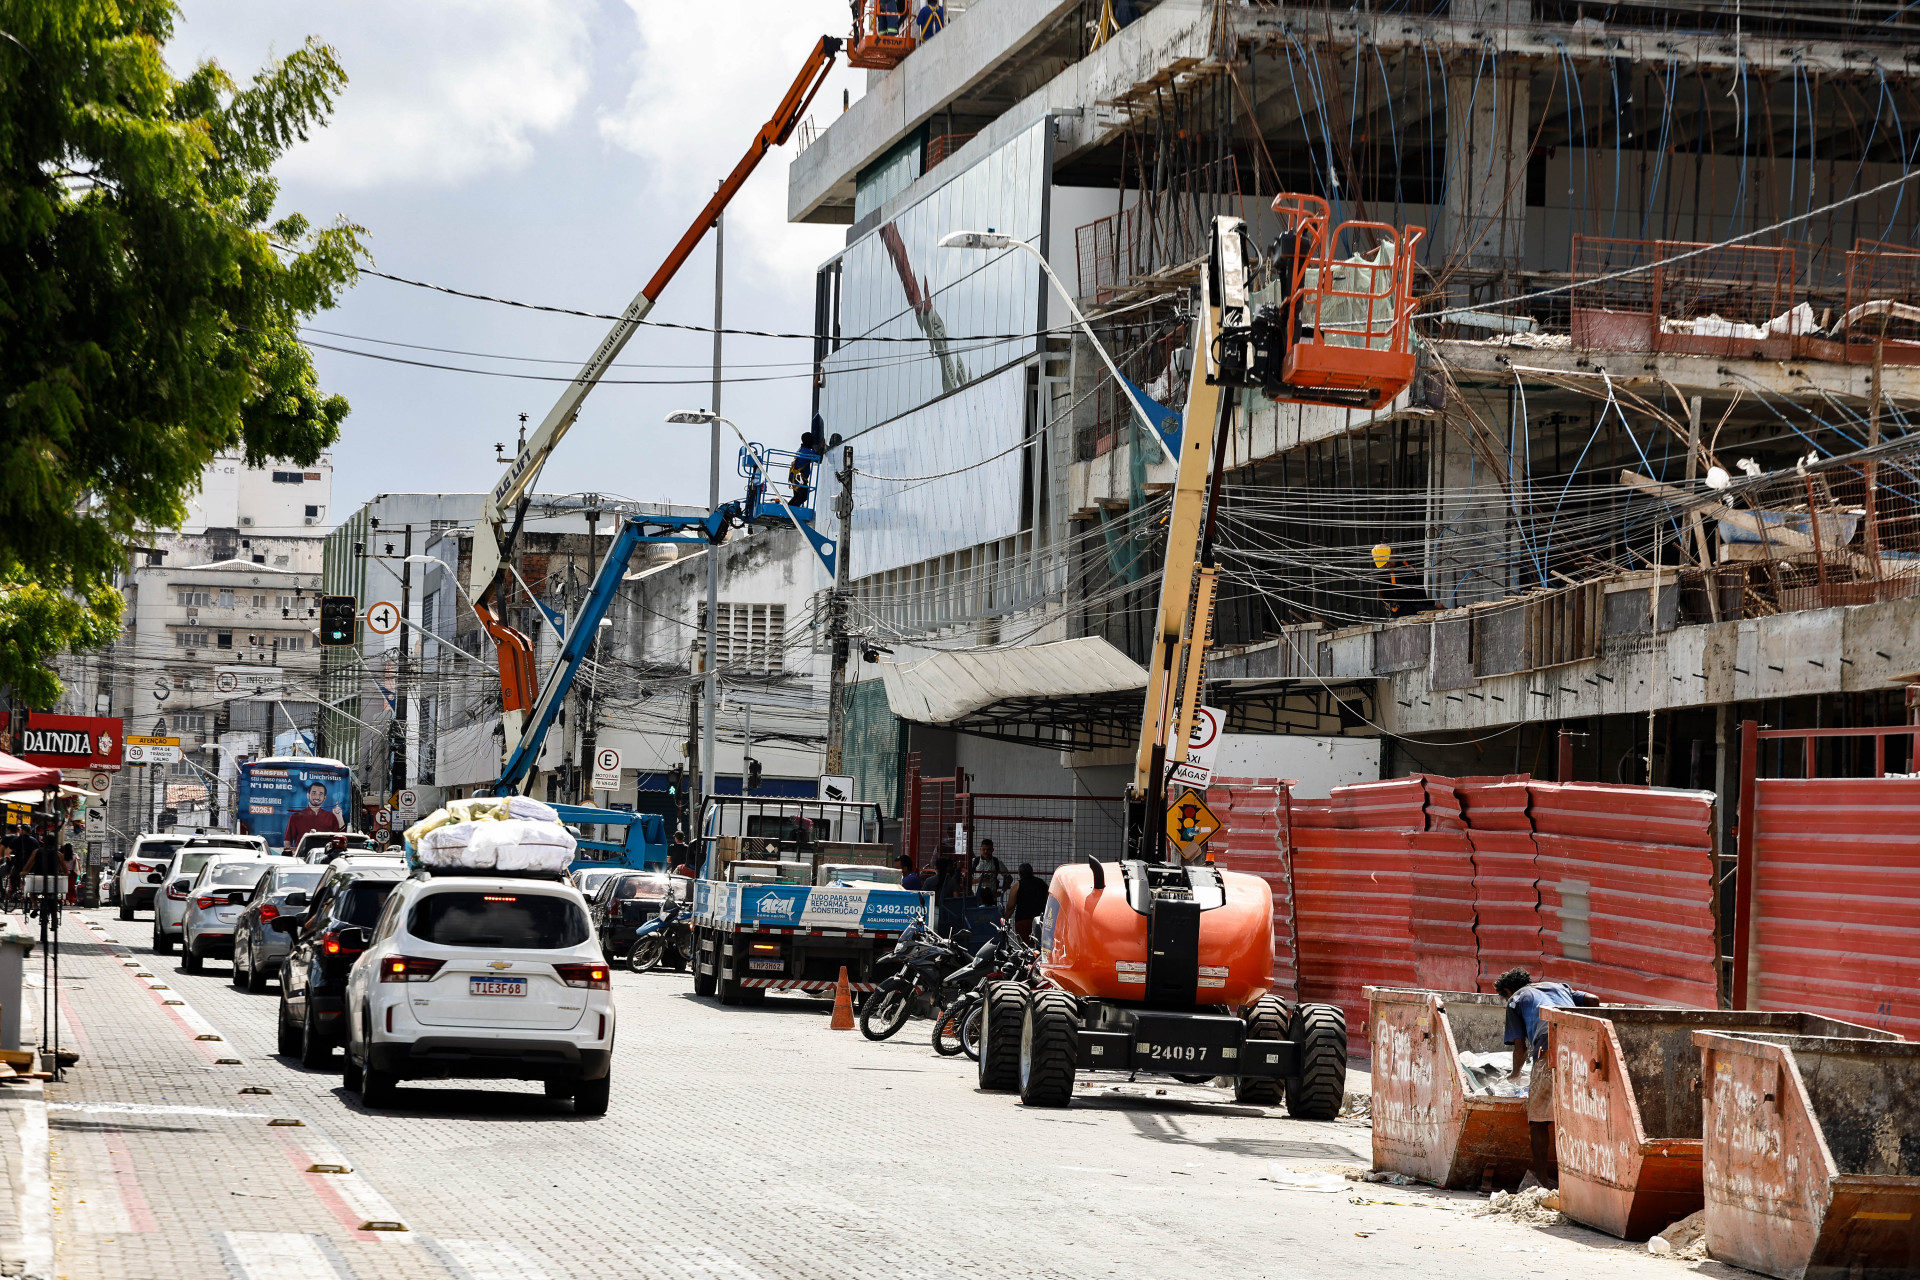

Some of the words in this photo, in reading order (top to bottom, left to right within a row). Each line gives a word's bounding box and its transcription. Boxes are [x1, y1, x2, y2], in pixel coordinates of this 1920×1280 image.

[882, 38, 903, 46] ESTAF
[496, 476, 511, 504] JLG
[511, 448, 531, 480] LIFT
[604, 754, 612, 766] E
[377, 831, 388, 839] 30
[830, 894, 848, 902] PARA
[811, 907, 859, 915] CONSTRUÇÃO
[475, 982, 521, 994] TIE3F68
[1151, 1044, 1208, 1061] 24097
